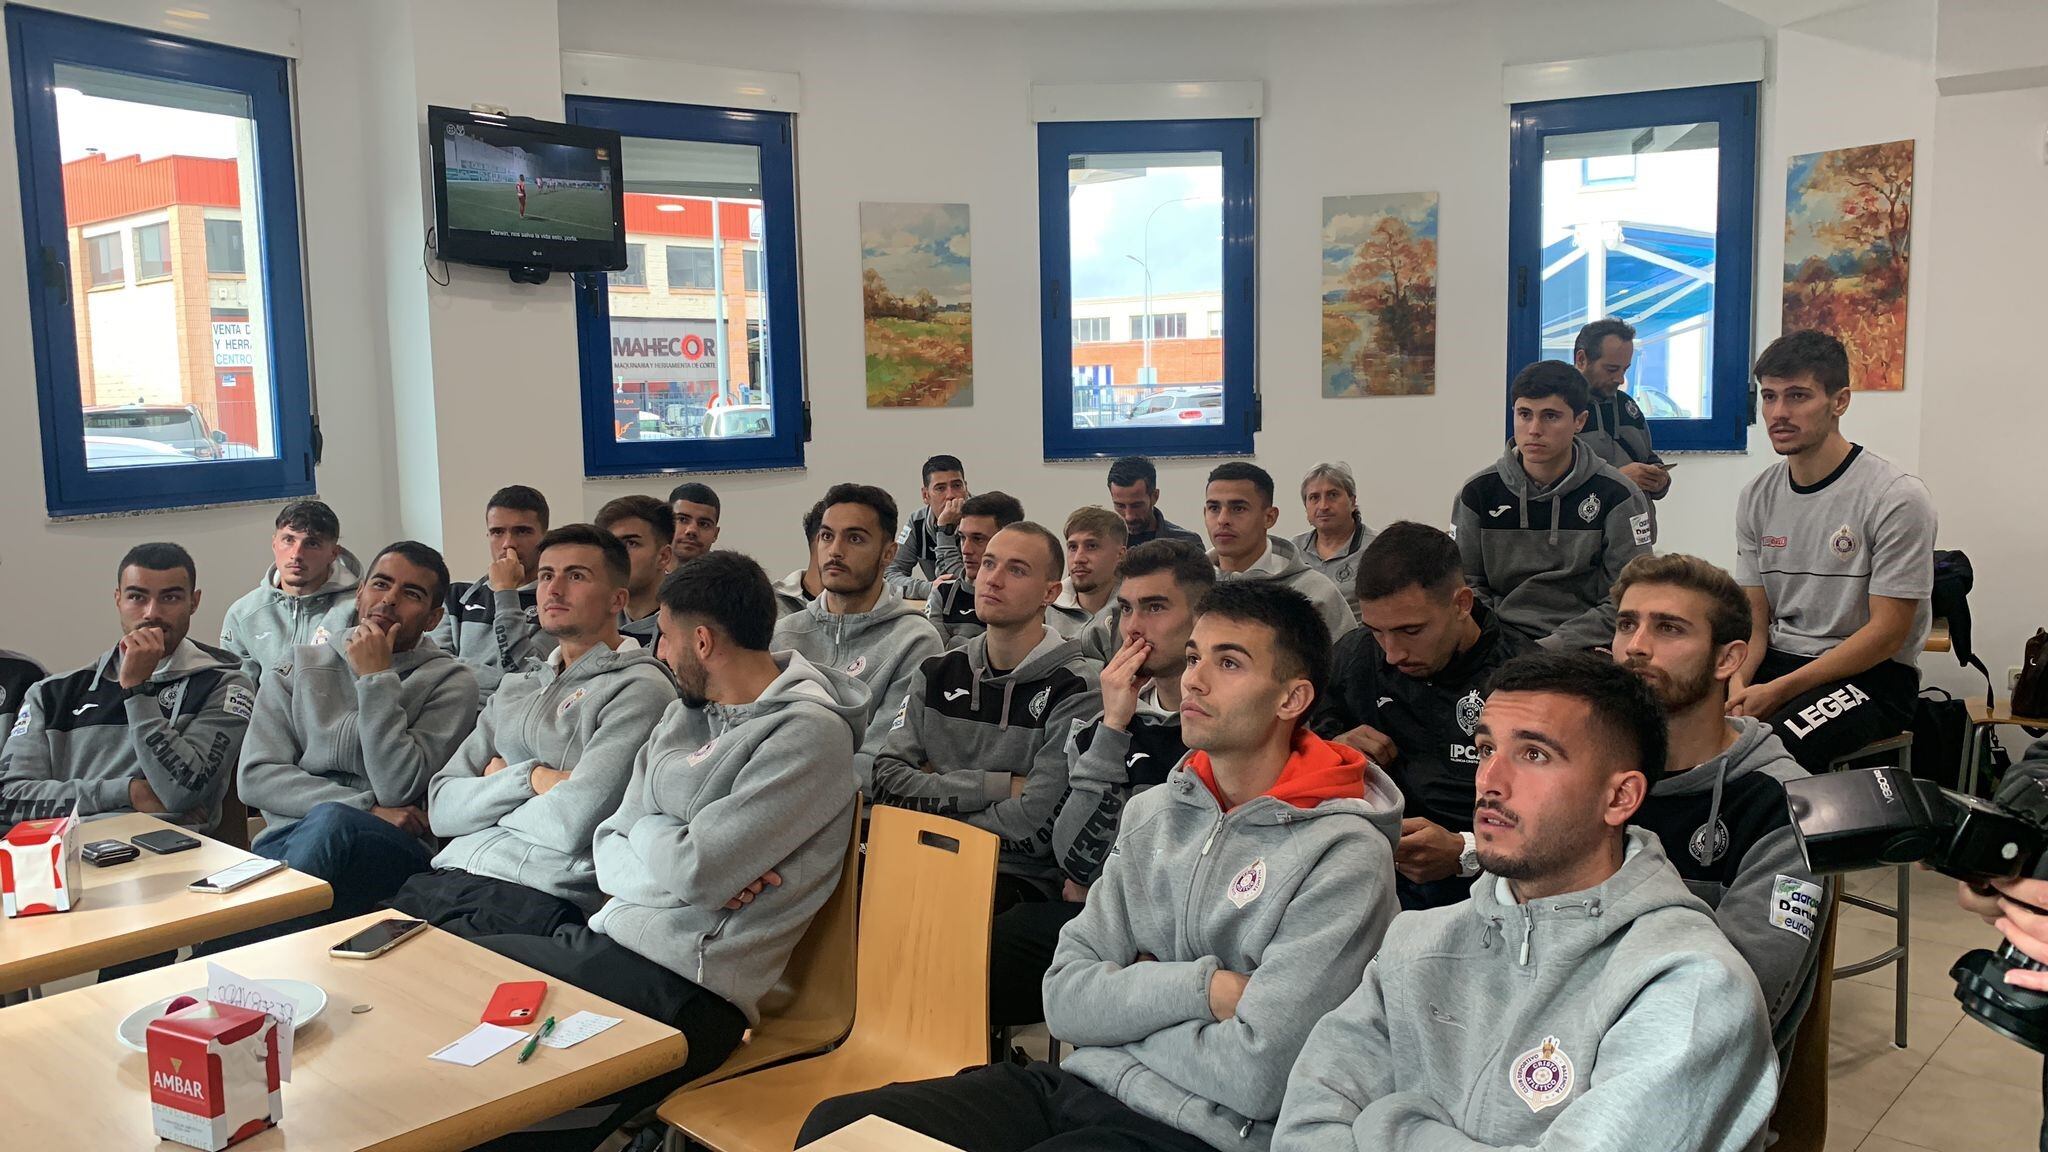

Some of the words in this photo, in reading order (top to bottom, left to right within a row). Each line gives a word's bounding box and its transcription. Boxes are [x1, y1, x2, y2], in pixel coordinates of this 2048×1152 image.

[213, 324, 241, 335] VENTA
[215, 339, 220, 350] Y
[612, 334, 716, 361] MAHECOR
[216, 354, 252, 365] CENTRO
[1784, 684, 1871, 740] LEGEA
[1517, 1054, 1539, 1078] DEPORTIVO
[1532, 1060, 1558, 1073] CRISTO
[153, 1070, 204, 1100] AMBAR
[1555, 1064, 1568, 1094] PALENCIA
